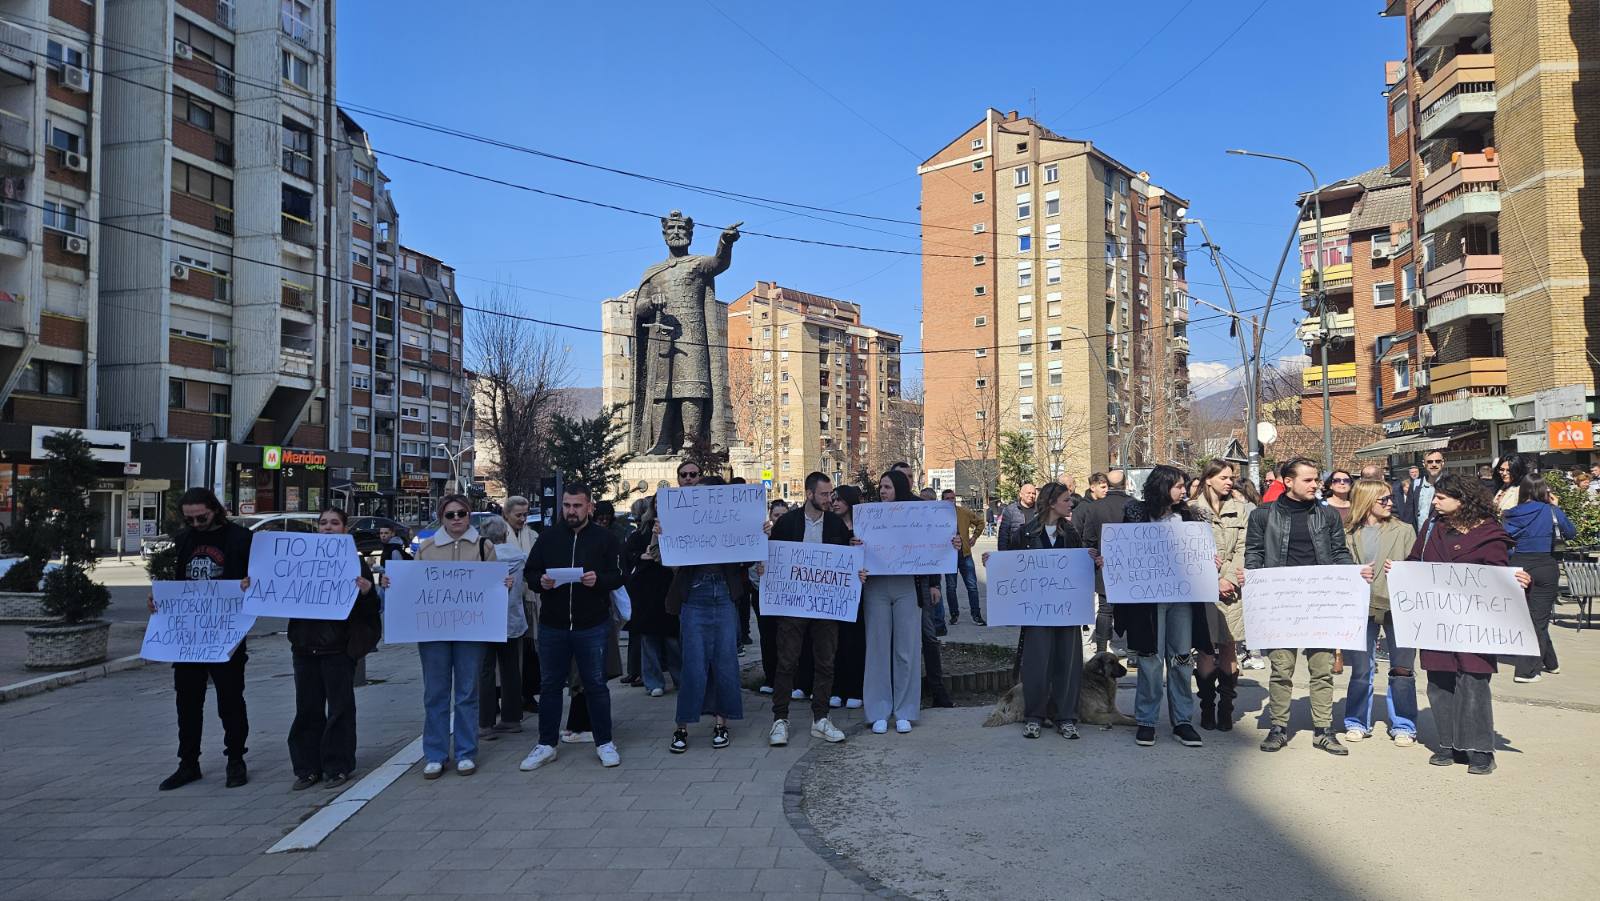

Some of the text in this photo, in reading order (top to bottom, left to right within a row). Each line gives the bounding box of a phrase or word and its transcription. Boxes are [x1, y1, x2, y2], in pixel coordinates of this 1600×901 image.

[1558, 425, 1584, 442] ria
[282, 450, 326, 465] Meridian
[667, 487, 763, 510] ГДЕ ЋЕ БИТИ
[1103, 526, 1129, 543] ОД
[1133, 525, 1175, 541] СКОРА
[274, 537, 348, 558] ПО КОМ
[1105, 544, 1125, 559] ЗА
[1129, 539, 1187, 557] ПРИШТИНУ
[273, 559, 348, 578] СИСТЕМУ
[768, 545, 854, 572] НЕ МОЖЕТЕ ДА
[1016, 553, 1069, 572] ЗАШТО
[1106, 557, 1123, 571] НА
[1127, 554, 1170, 570] КОСОВУ
[192, 567, 209, 578] 66
[442, 568, 474, 583] МАРТ
[790, 566, 852, 587] РАЗДВАЈАТЕ
[1107, 572, 1124, 587] ЗА
[1128, 567, 1176, 583] БЕОГРАД
[1431, 563, 1488, 588] ГЛАС
[246, 579, 278, 602] ДА
[415, 588, 485, 605] ЛЕГАЛНИ
[996, 576, 1080, 597] БЕОГРАД
[1129, 581, 1192, 600] ОДАВНО
[155, 597, 244, 615] МАРТОВСКИ ПОГР
[806, 595, 848, 618] ЗАЈЕДНО
[1018, 601, 1072, 621] ЋУТИ?
[1393, 590, 1513, 615] ВАПИЈУЋЕГ
[167, 614, 236, 631] ОВЕ ГОДИНЕ
[416, 609, 486, 633] ПОГРОМ
[146, 630, 197, 646] ДОЛАЗИ
[1413, 621, 1524, 647] У ПУСТИЊИ
